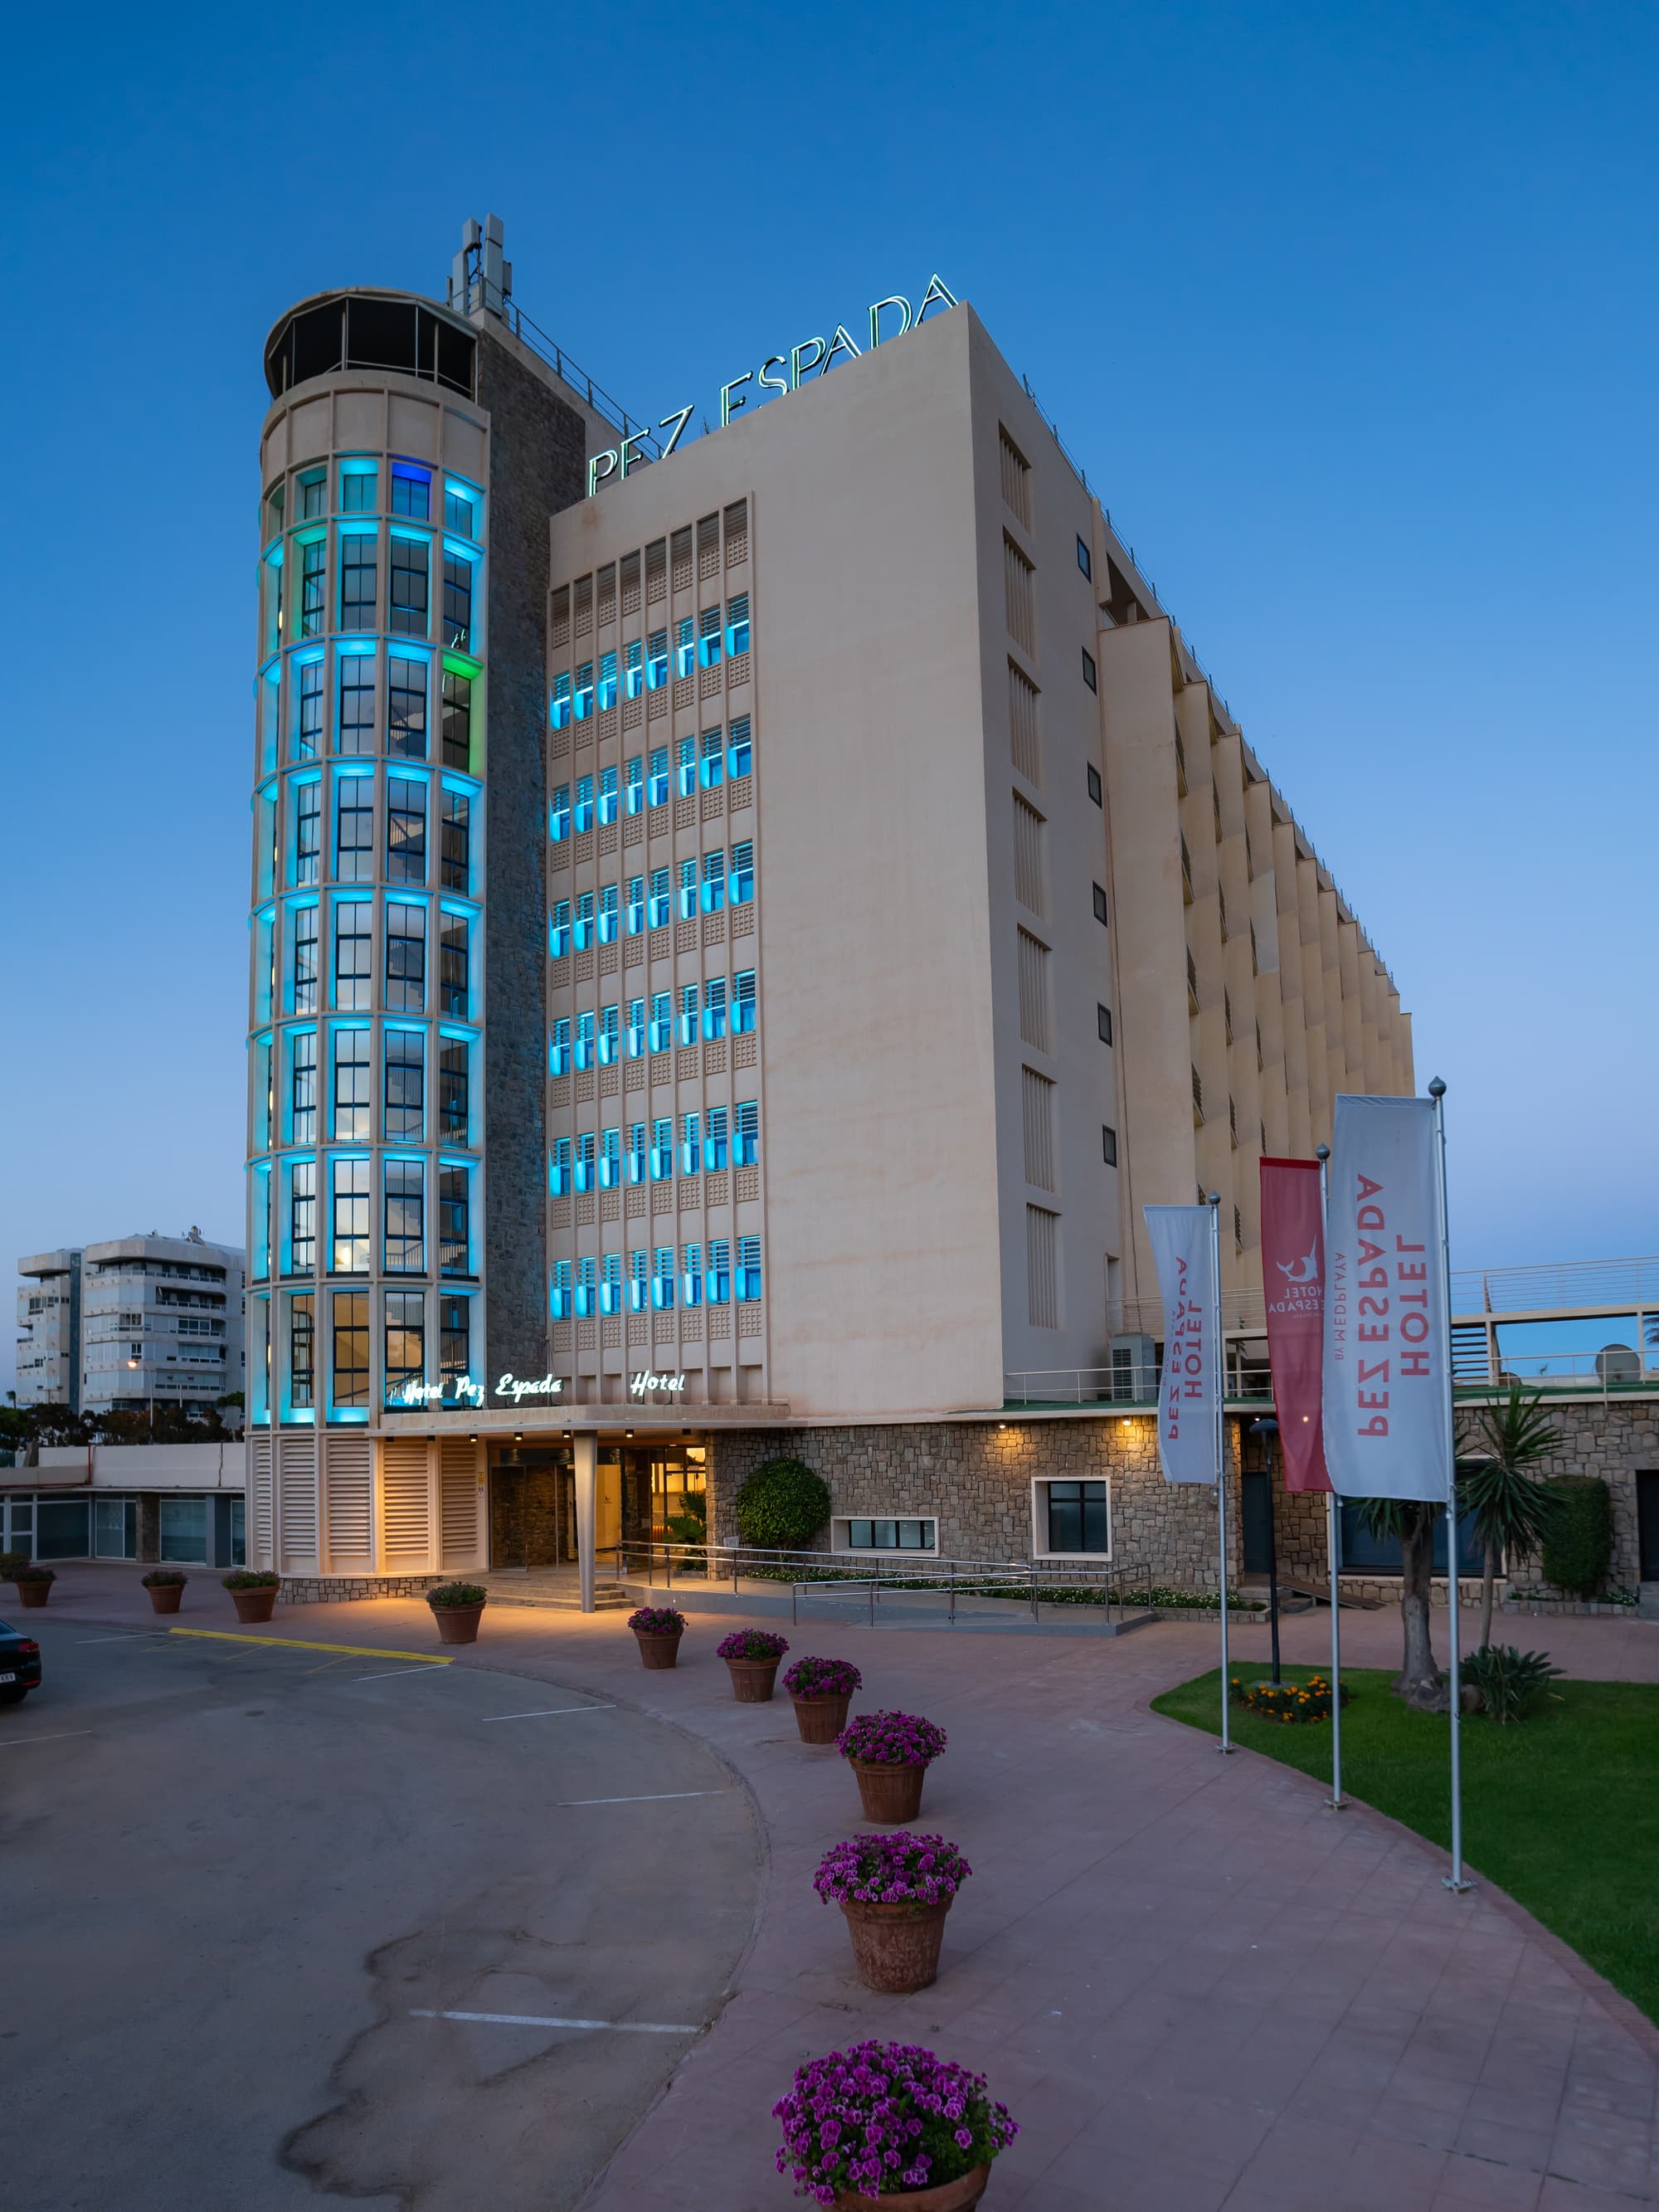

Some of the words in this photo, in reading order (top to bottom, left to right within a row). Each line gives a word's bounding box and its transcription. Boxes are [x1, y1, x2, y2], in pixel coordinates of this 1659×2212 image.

[588, 404, 695, 498] PEZ
[719, 272, 960, 428] ESPADA
[402, 1379, 445, 1406] Hotel
[455, 1375, 485, 1407] Pez
[495, 1373, 562, 1403] Espada
[630, 1370, 685, 1396] Hotel
